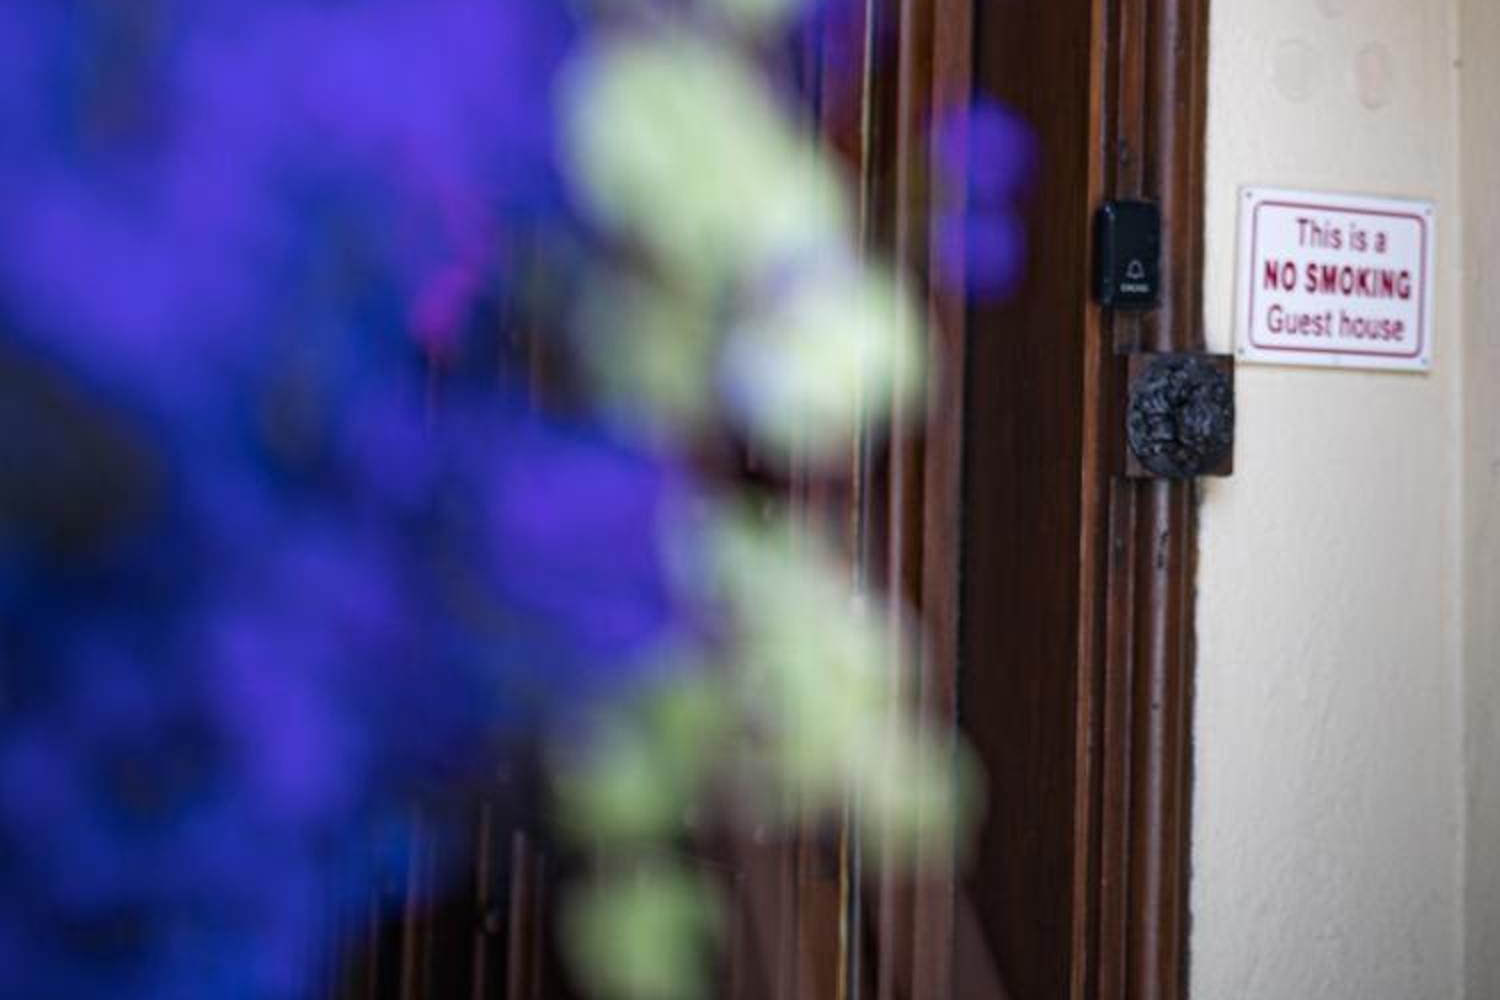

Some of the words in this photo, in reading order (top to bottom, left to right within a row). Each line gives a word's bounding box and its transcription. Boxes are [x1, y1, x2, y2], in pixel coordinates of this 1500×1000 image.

[1297, 217, 1342, 250] This
[1350, 223, 1367, 253] is
[1374, 231, 1388, 254] a
[1264, 260, 1297, 291] NO
[1305, 263, 1411, 300] SMOKING
[1267, 304, 1333, 338] Guest
[1339, 309, 1405, 342] house
